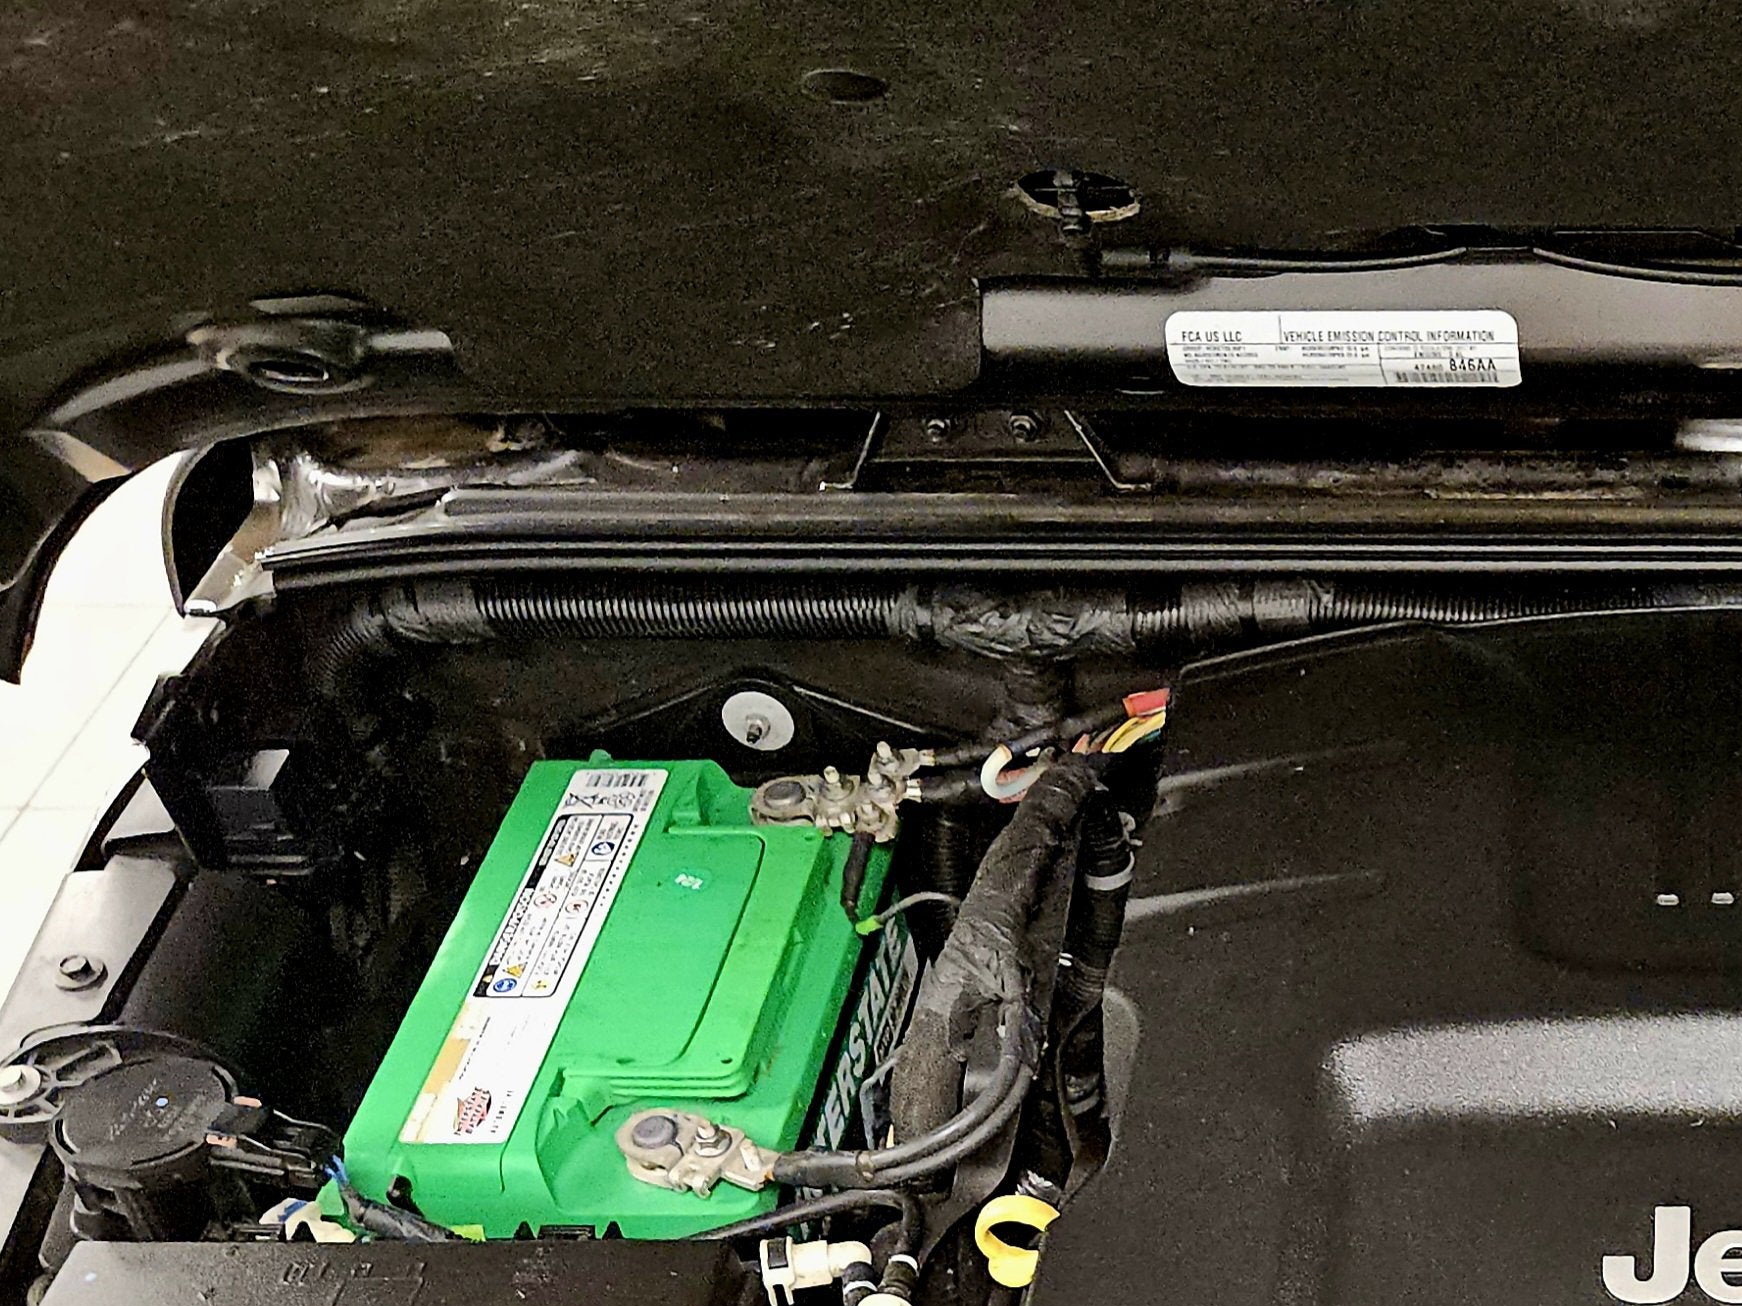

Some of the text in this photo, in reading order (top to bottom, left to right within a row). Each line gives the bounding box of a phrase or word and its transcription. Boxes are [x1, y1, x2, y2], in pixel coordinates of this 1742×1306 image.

[1181, 331, 1242, 342] FCA US LLC
[1284, 331, 1495, 342] VEHICLE EMISSION CONTROL INFORMATION
[1449, 358, 1496, 372] 846AA
